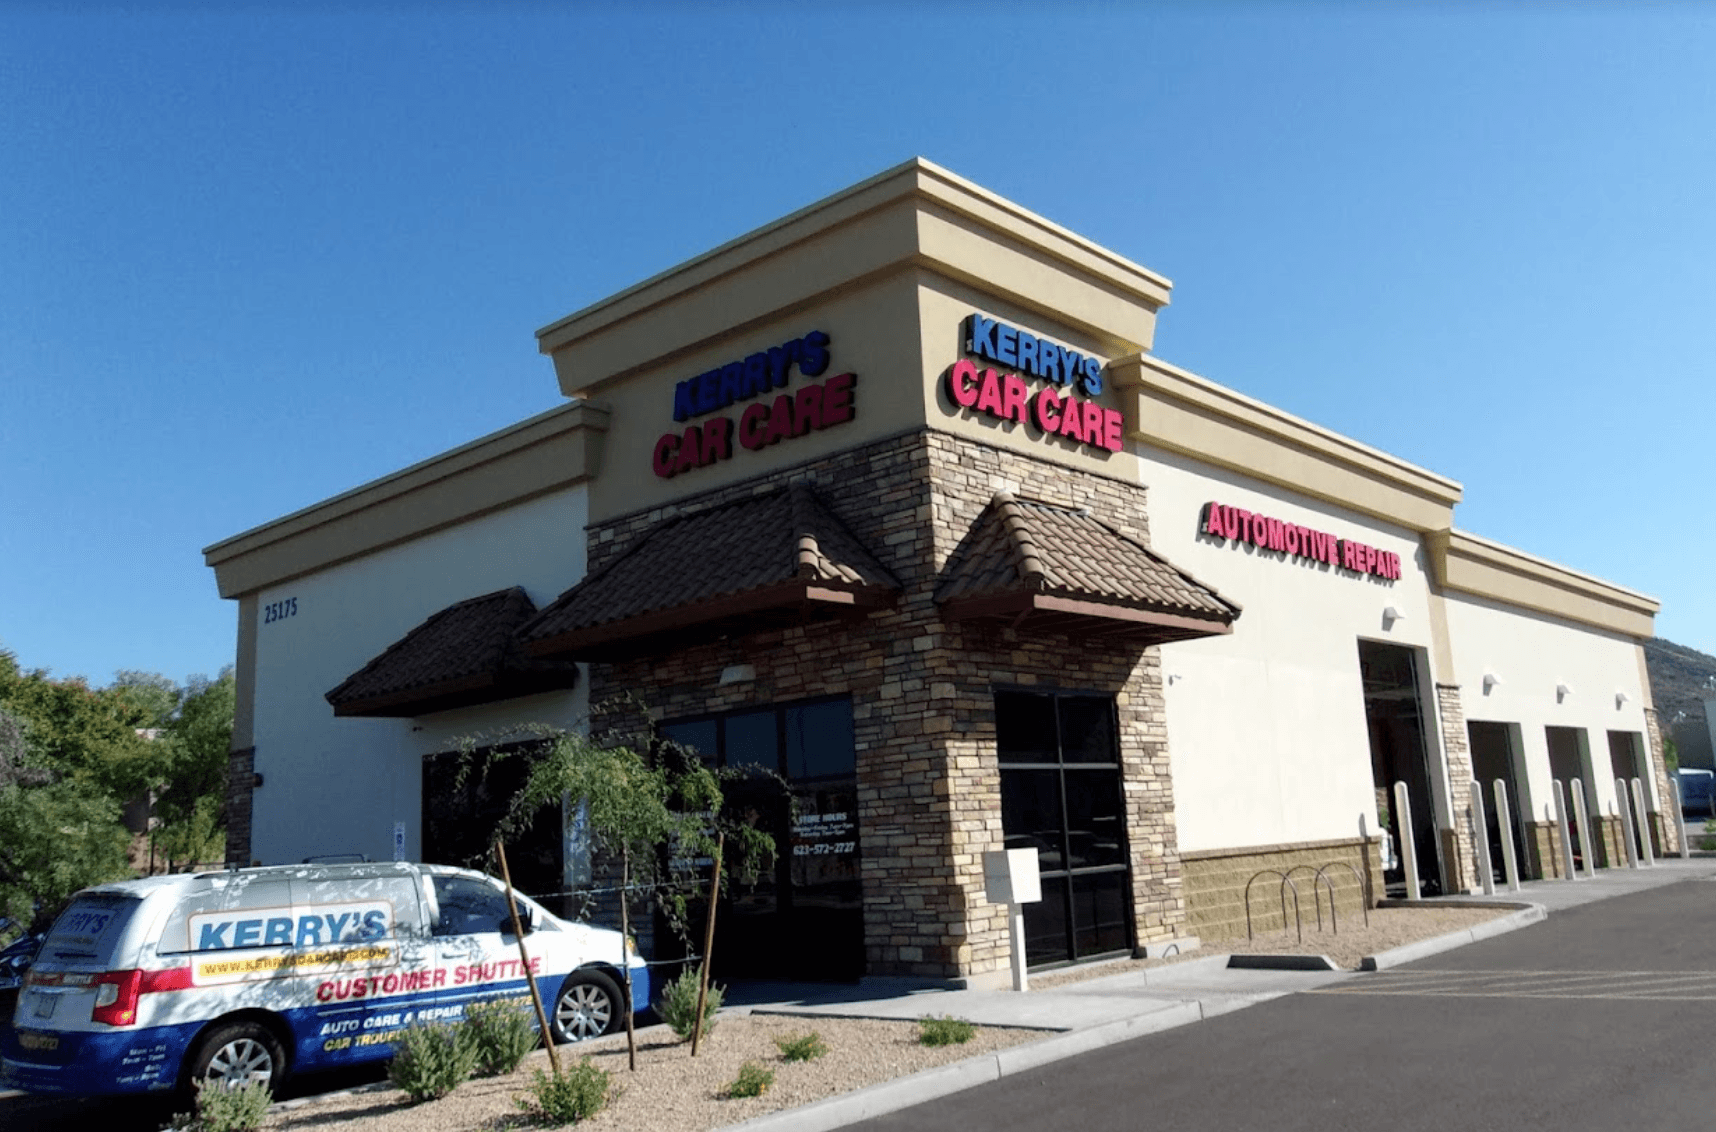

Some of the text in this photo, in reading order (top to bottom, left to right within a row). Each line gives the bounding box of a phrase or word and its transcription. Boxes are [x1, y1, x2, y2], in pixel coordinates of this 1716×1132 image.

[673, 330, 830, 422] KERRY'S
[967, 313, 1102, 395] KERRY'S
[653, 373, 856, 478] CAR CARE
[949, 358, 1124, 453] CAR CARE
[1205, 501, 1402, 580] AUTOMOTIVE REPAIR
[265, 597, 297, 624] 25175
[792, 841, 856, 856] 623-572-2727
[199, 910, 386, 951] KERRY'S
[316, 956, 542, 1002] CUSTOMER SHUTTLE
[320, 1019, 360, 1036] AUTO
[363, 1013, 402, 1030] CARE
[417, 1004, 464, 1021] REPAIR
[323, 1036, 352, 1052] CAR
